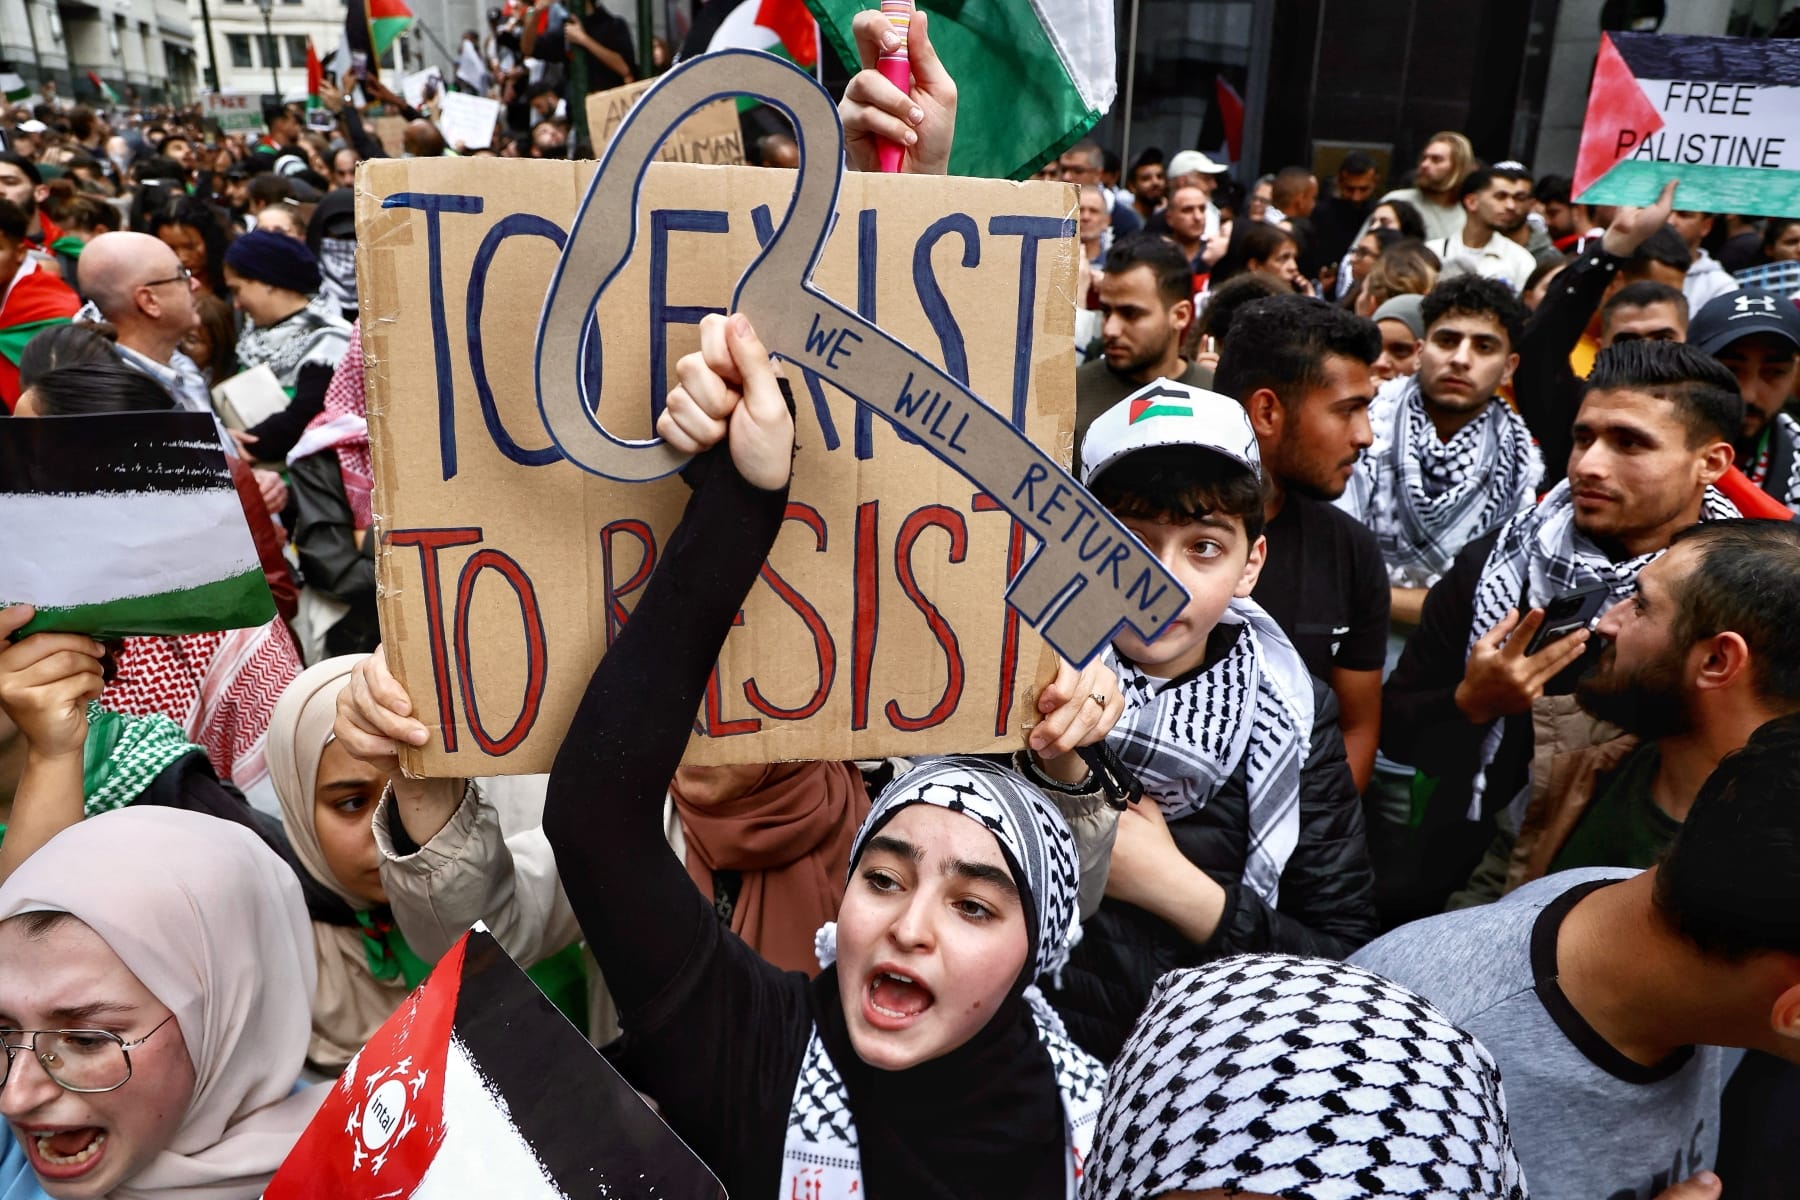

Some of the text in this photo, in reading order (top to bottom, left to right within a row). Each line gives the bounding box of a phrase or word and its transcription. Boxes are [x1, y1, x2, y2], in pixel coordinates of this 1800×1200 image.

[1614, 129, 1786, 168] PALISTINE
[1664, 82, 1756, 115] FREE
[381, 192, 603, 480] TO
[805, 313, 1168, 622] WE WILL RETURN.
[382, 527, 548, 757] TO
[371, 1094, 396, 1134] intal
